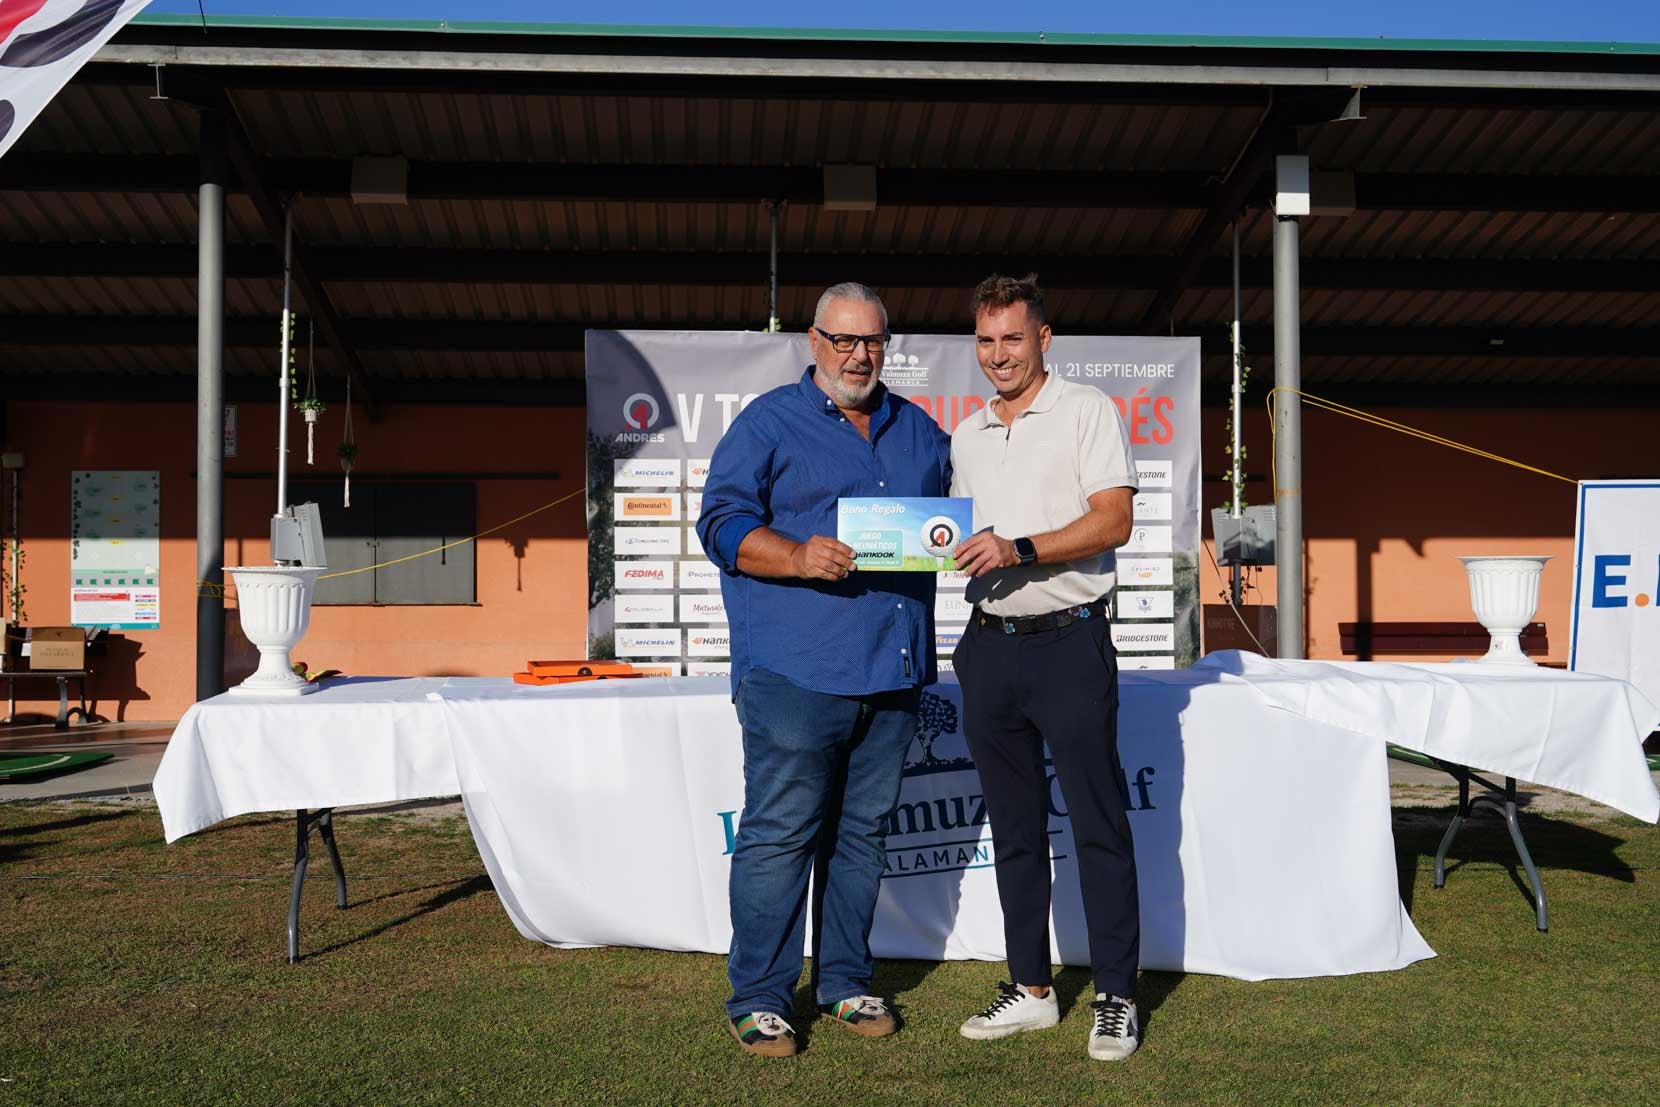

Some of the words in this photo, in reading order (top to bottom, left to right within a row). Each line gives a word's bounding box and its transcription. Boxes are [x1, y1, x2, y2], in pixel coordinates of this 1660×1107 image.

[1065, 363, 1080, 377] 21
[1085, 364, 1175, 378] SEPTIEMBRE
[677, 394, 704, 442] V
[627, 501, 662, 511] Continental
[841, 504, 868, 513] Bono
[871, 503, 906, 516] Regalo
[624, 570, 664, 578] FEDIMA
[1116, 634, 1168, 642] BRIDGESTONE
